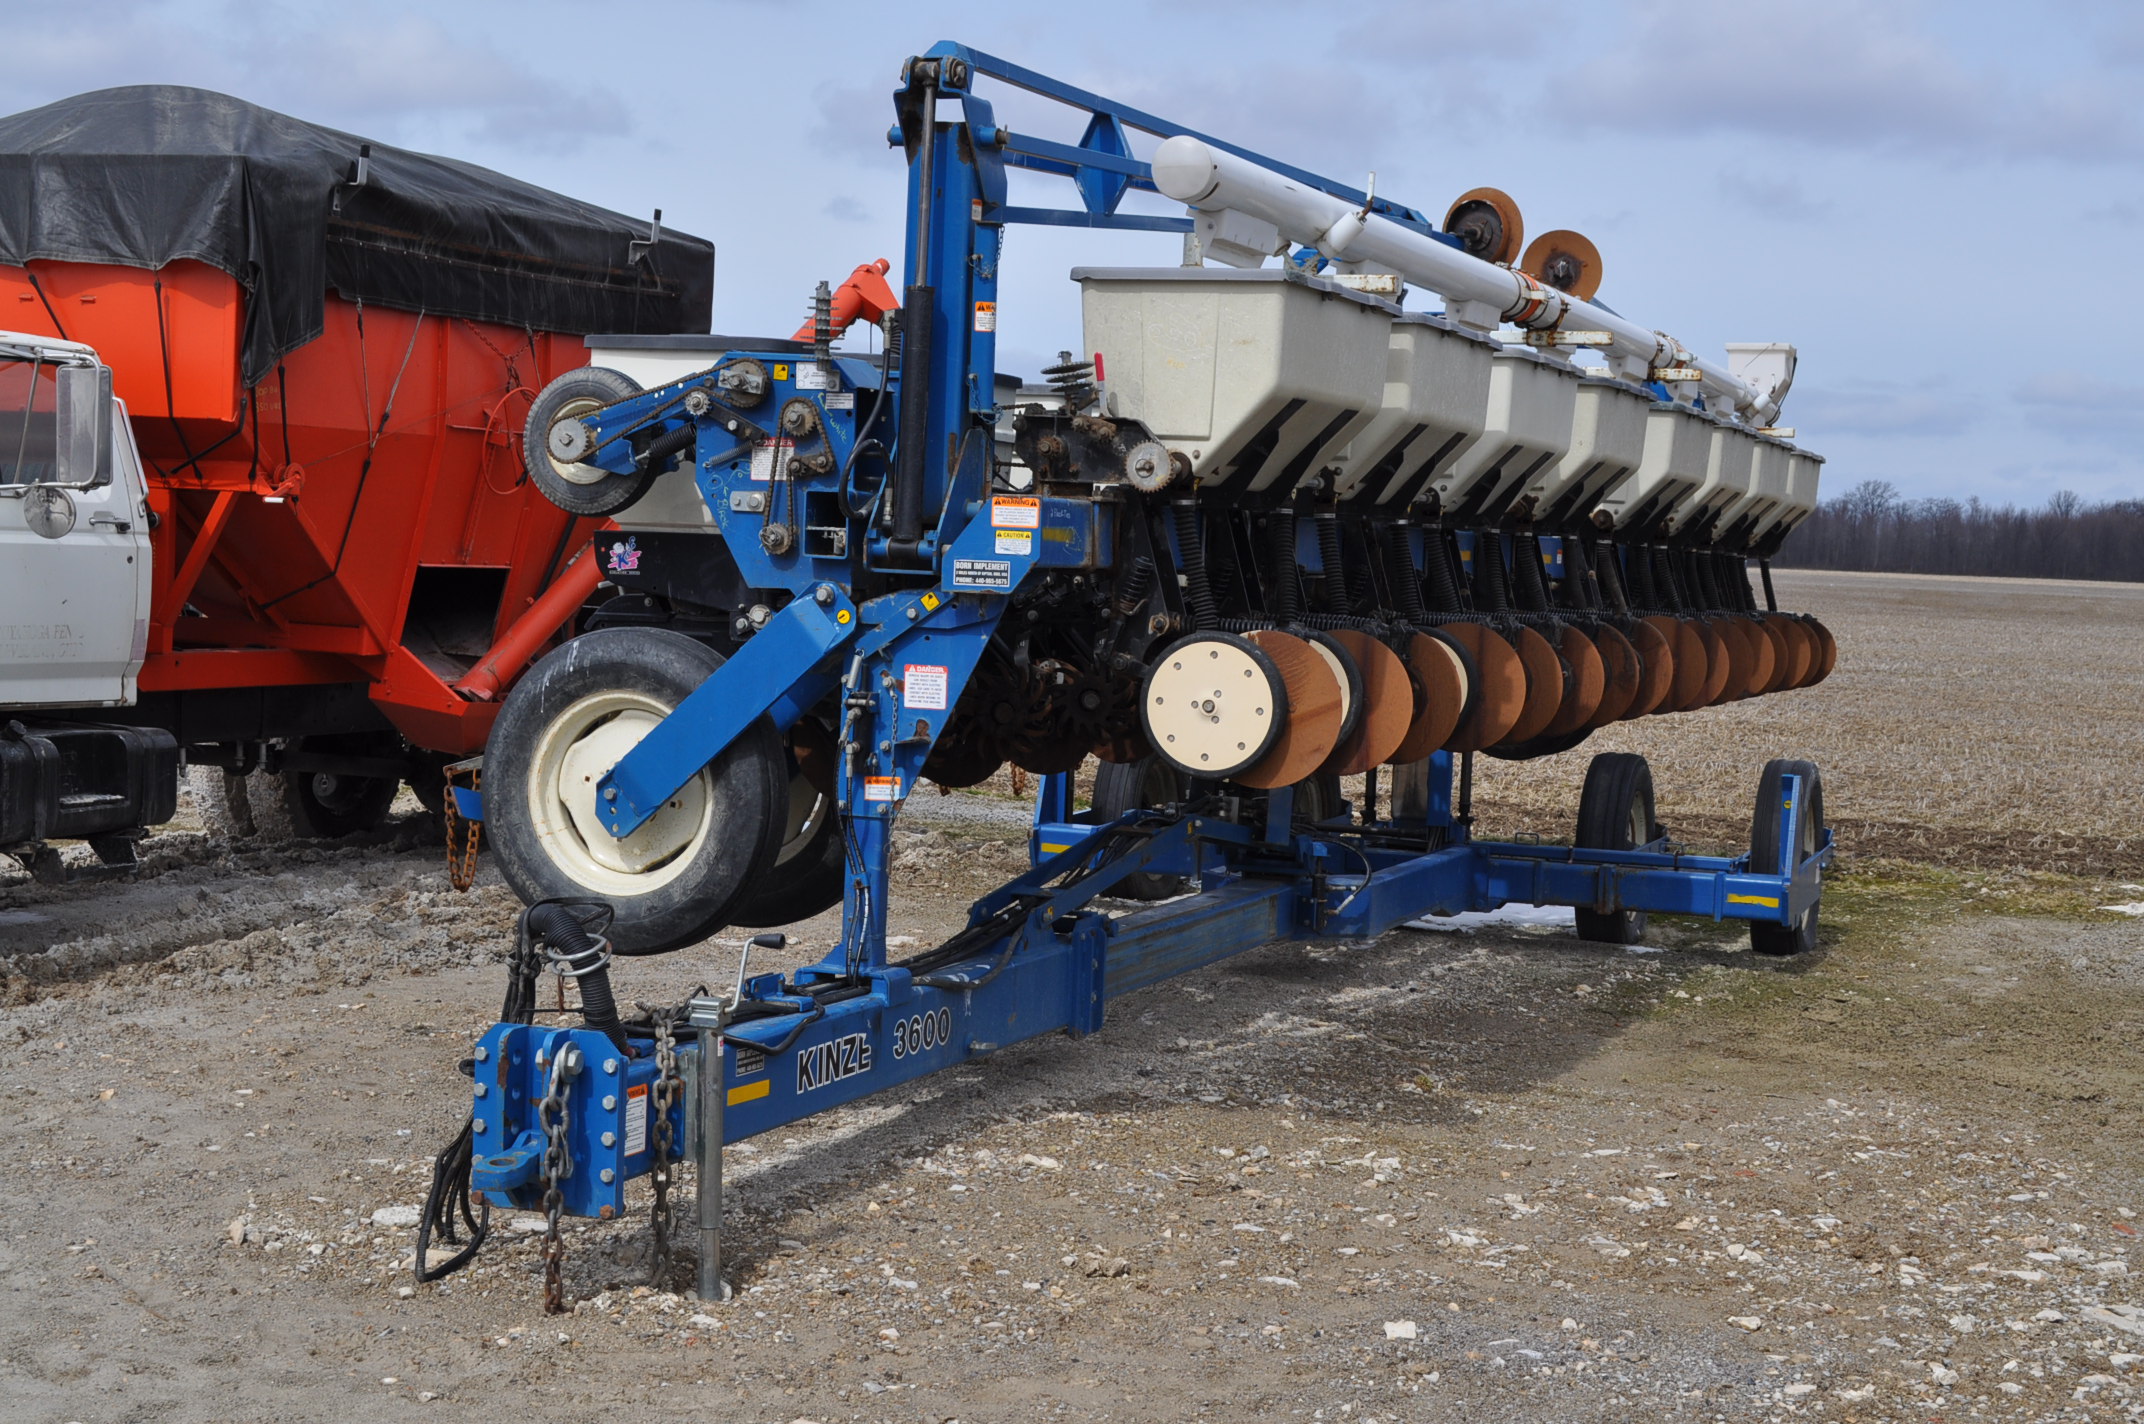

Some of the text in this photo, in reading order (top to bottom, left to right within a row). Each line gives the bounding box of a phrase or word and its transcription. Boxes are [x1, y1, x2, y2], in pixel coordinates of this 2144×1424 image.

[1001, 498, 1031, 506] WARNING
[1003, 530, 1025, 538] CAUTION
[956, 561, 1009, 571] BORN IMPLEMENT
[916, 665, 944, 673] DANGER
[893, 1006, 951, 1060] 3600
[797, 1033, 871, 1095] KINZE
